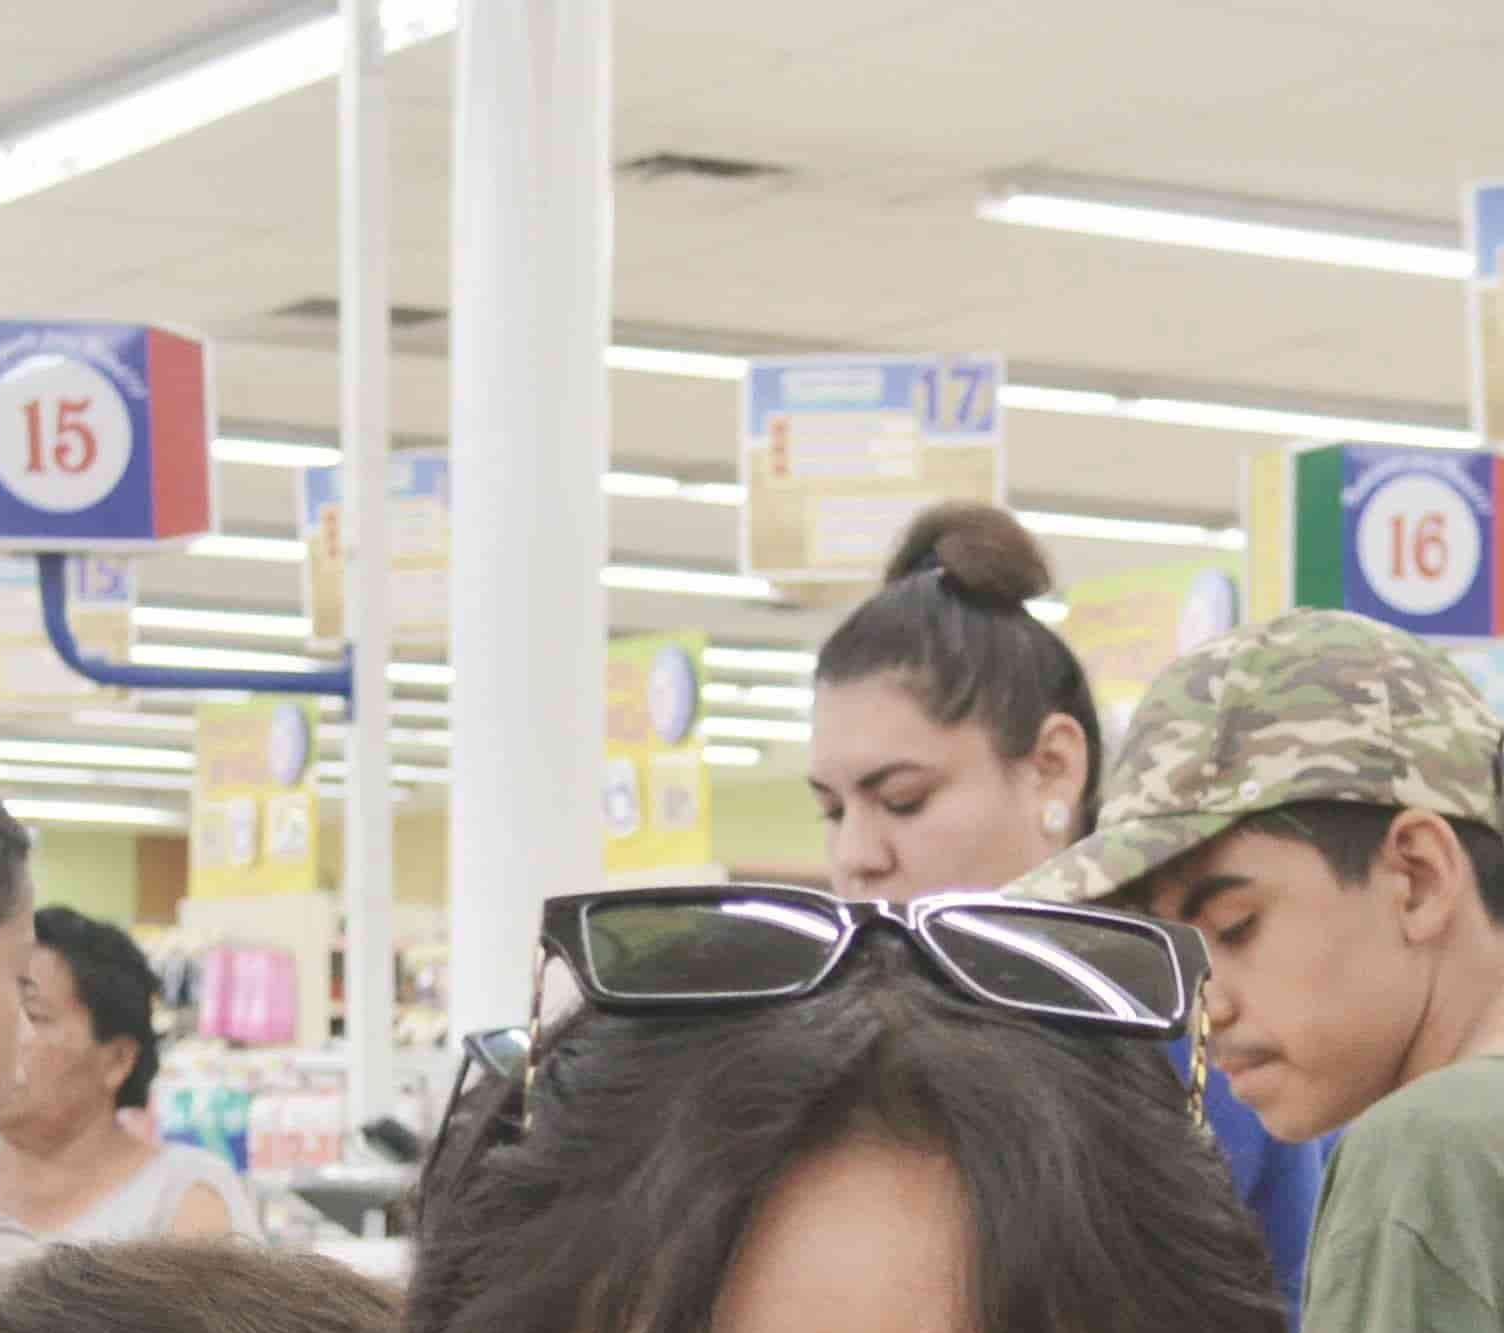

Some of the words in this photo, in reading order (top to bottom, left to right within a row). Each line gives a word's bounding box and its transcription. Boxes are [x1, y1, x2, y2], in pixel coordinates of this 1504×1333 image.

[921, 366, 982, 425] 17
[22, 396, 97, 475] 15
[1389, 511, 1450, 582] 16
